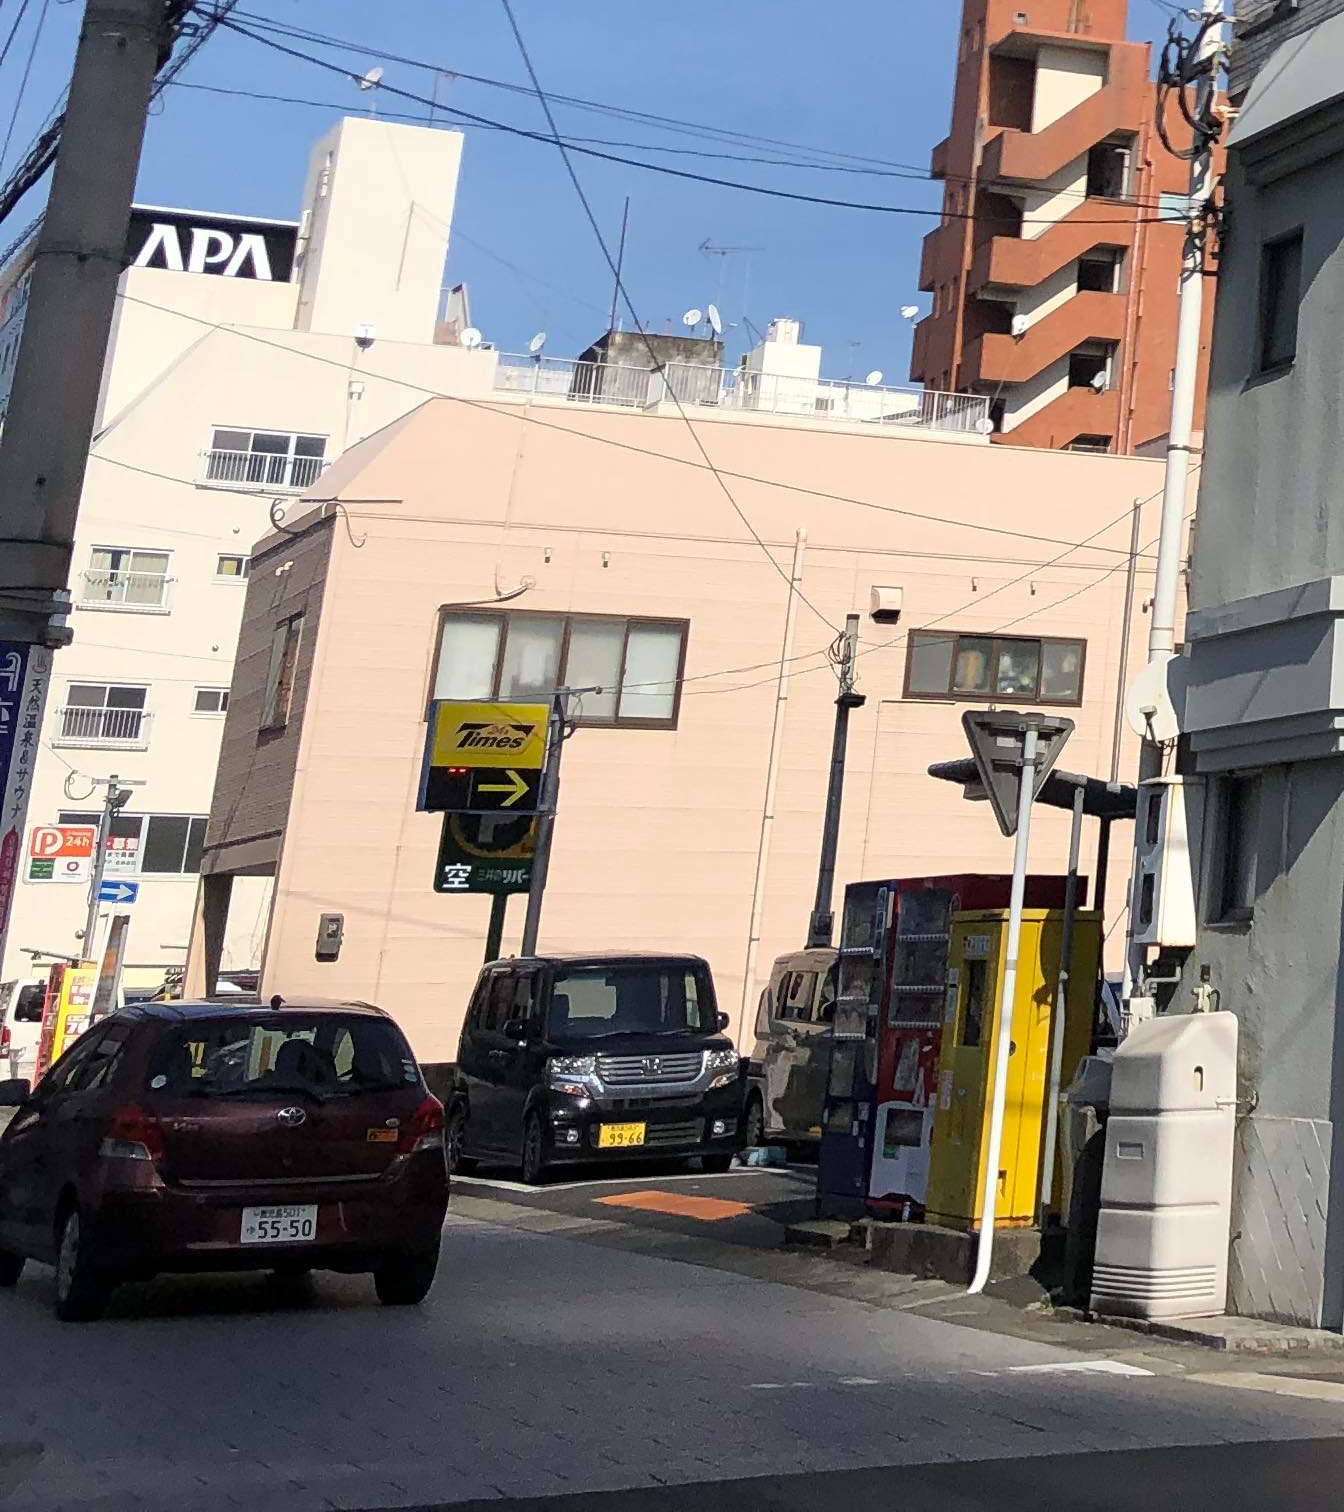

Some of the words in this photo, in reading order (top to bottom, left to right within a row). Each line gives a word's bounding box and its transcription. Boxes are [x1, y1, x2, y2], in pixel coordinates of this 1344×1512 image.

[134, 223, 272, 280] APA
[456, 723, 536, 748] Times
[65, 836, 90, 847] 24h
[442, 863, 472, 888] 空
[257, 1218, 313, 1239] 55-50
